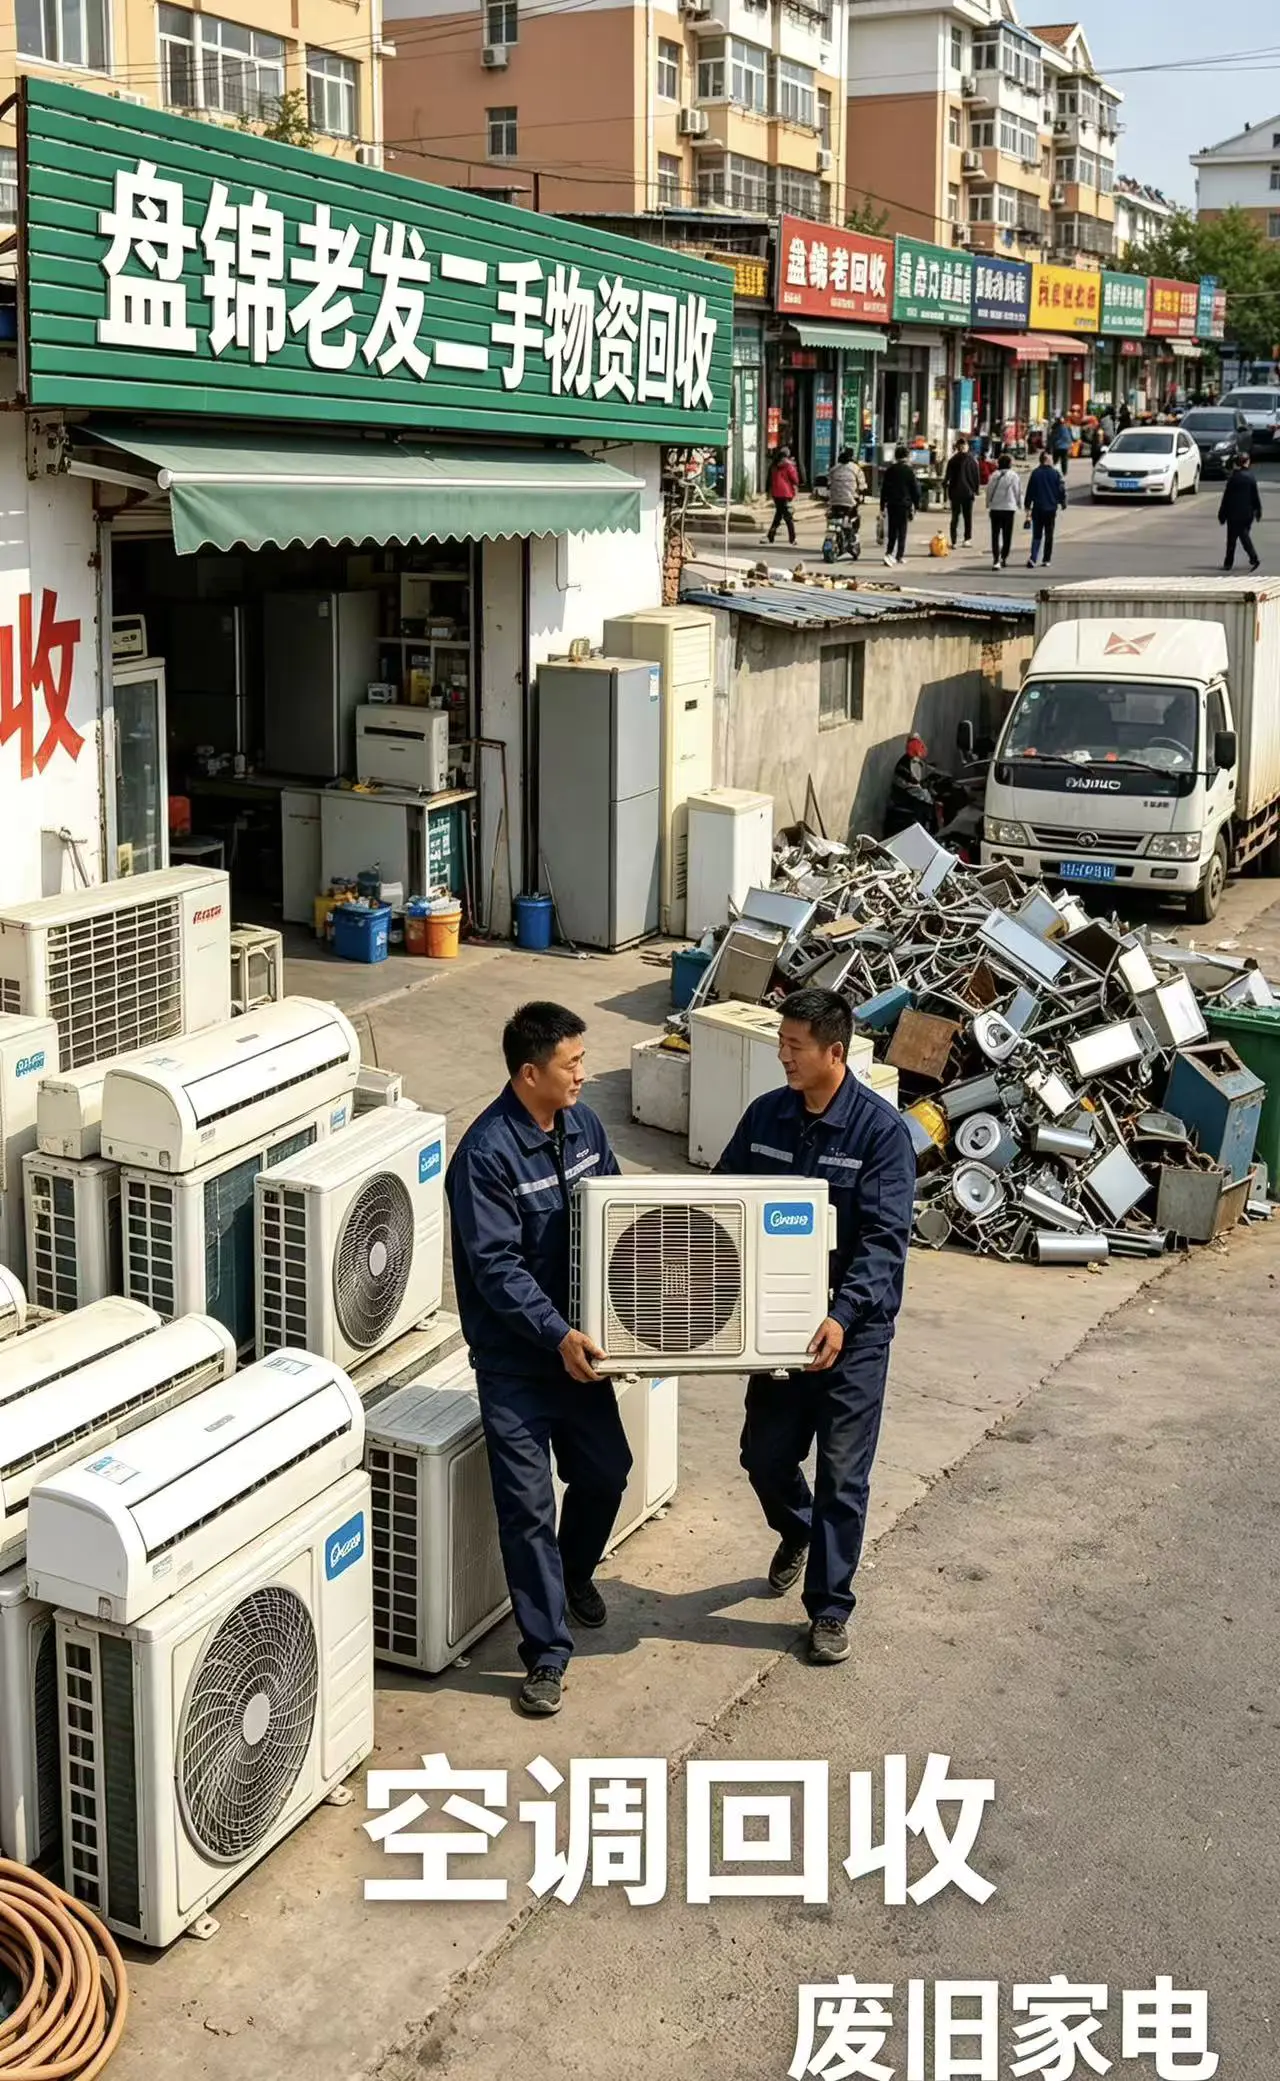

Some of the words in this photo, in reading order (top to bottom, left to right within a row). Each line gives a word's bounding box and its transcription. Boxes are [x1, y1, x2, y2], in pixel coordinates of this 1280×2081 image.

[98, 159, 719, 410] 盘锦老发二手物资回收
[0, 588, 85, 780] 收
